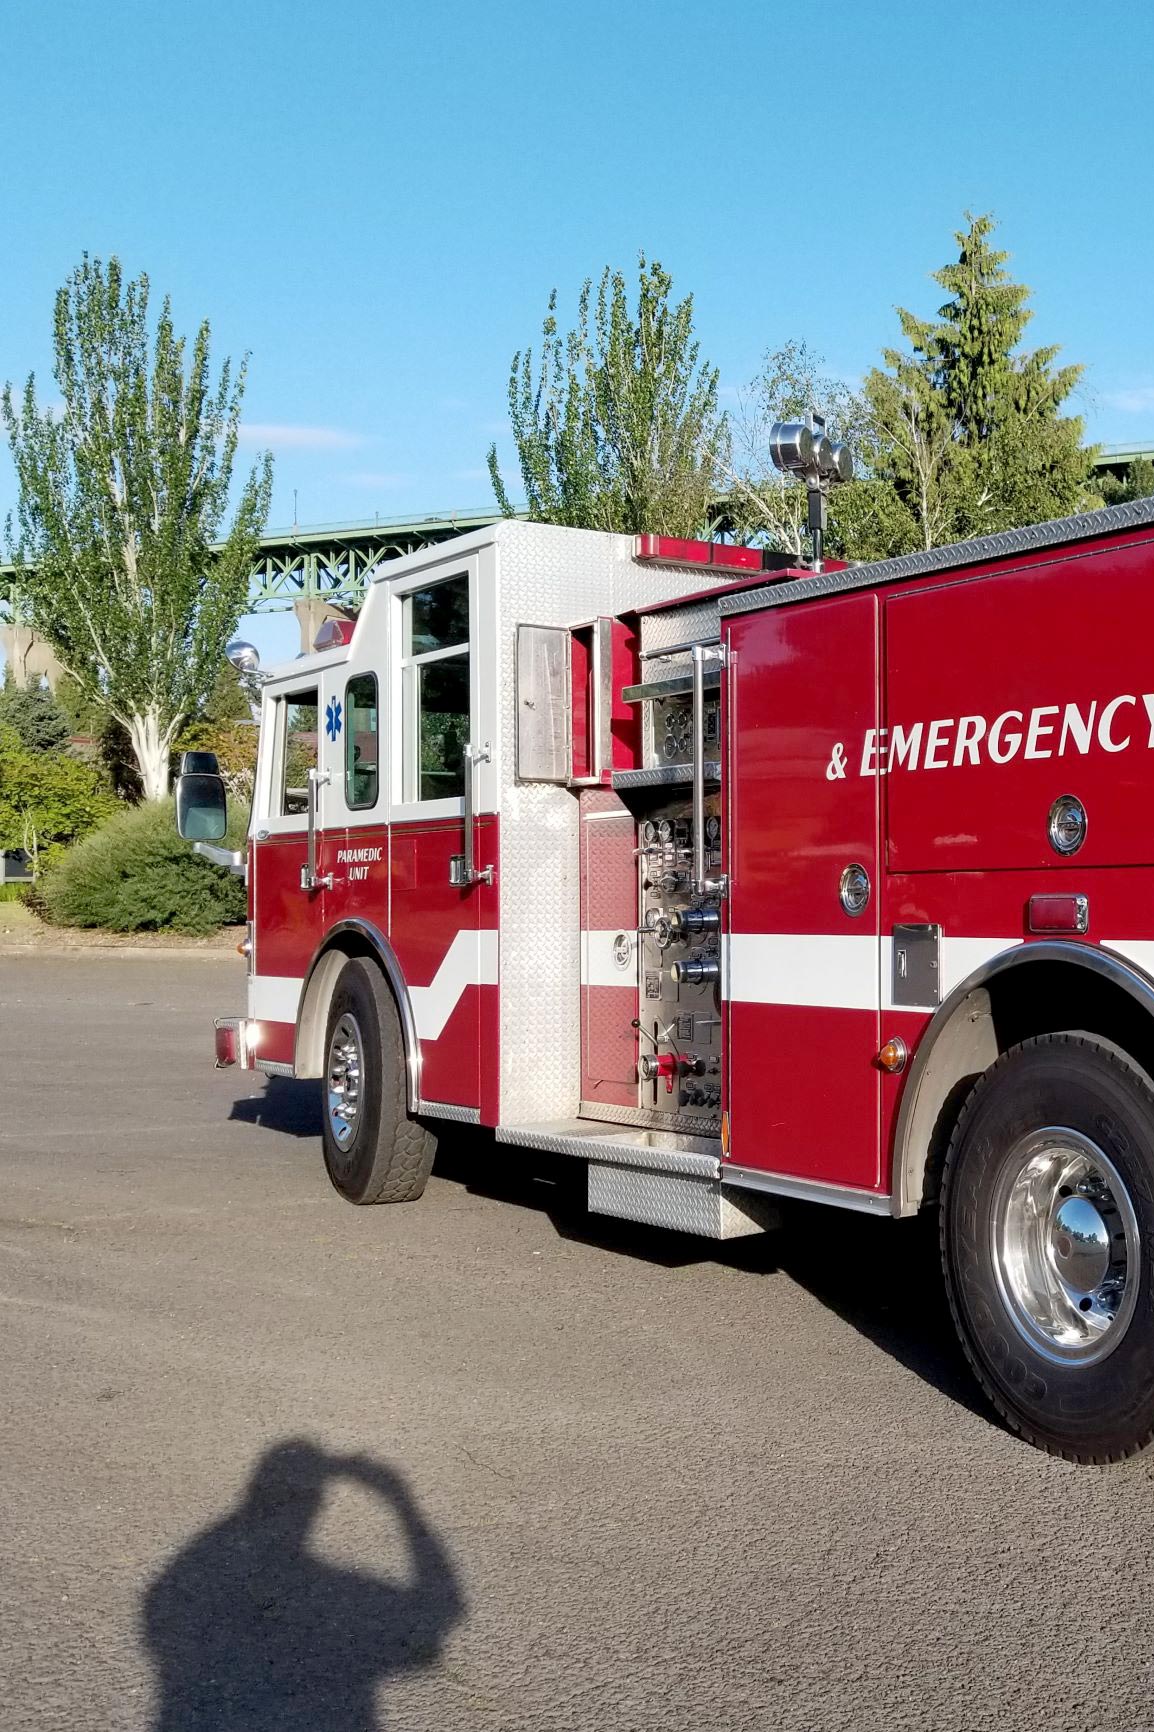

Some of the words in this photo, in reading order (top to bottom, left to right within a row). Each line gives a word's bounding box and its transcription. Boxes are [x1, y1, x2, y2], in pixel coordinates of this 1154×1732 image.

[825, 742, 848, 780] &
[337, 847, 383, 863] PARAMEDIC
[349, 866, 369, 881] UNIT
